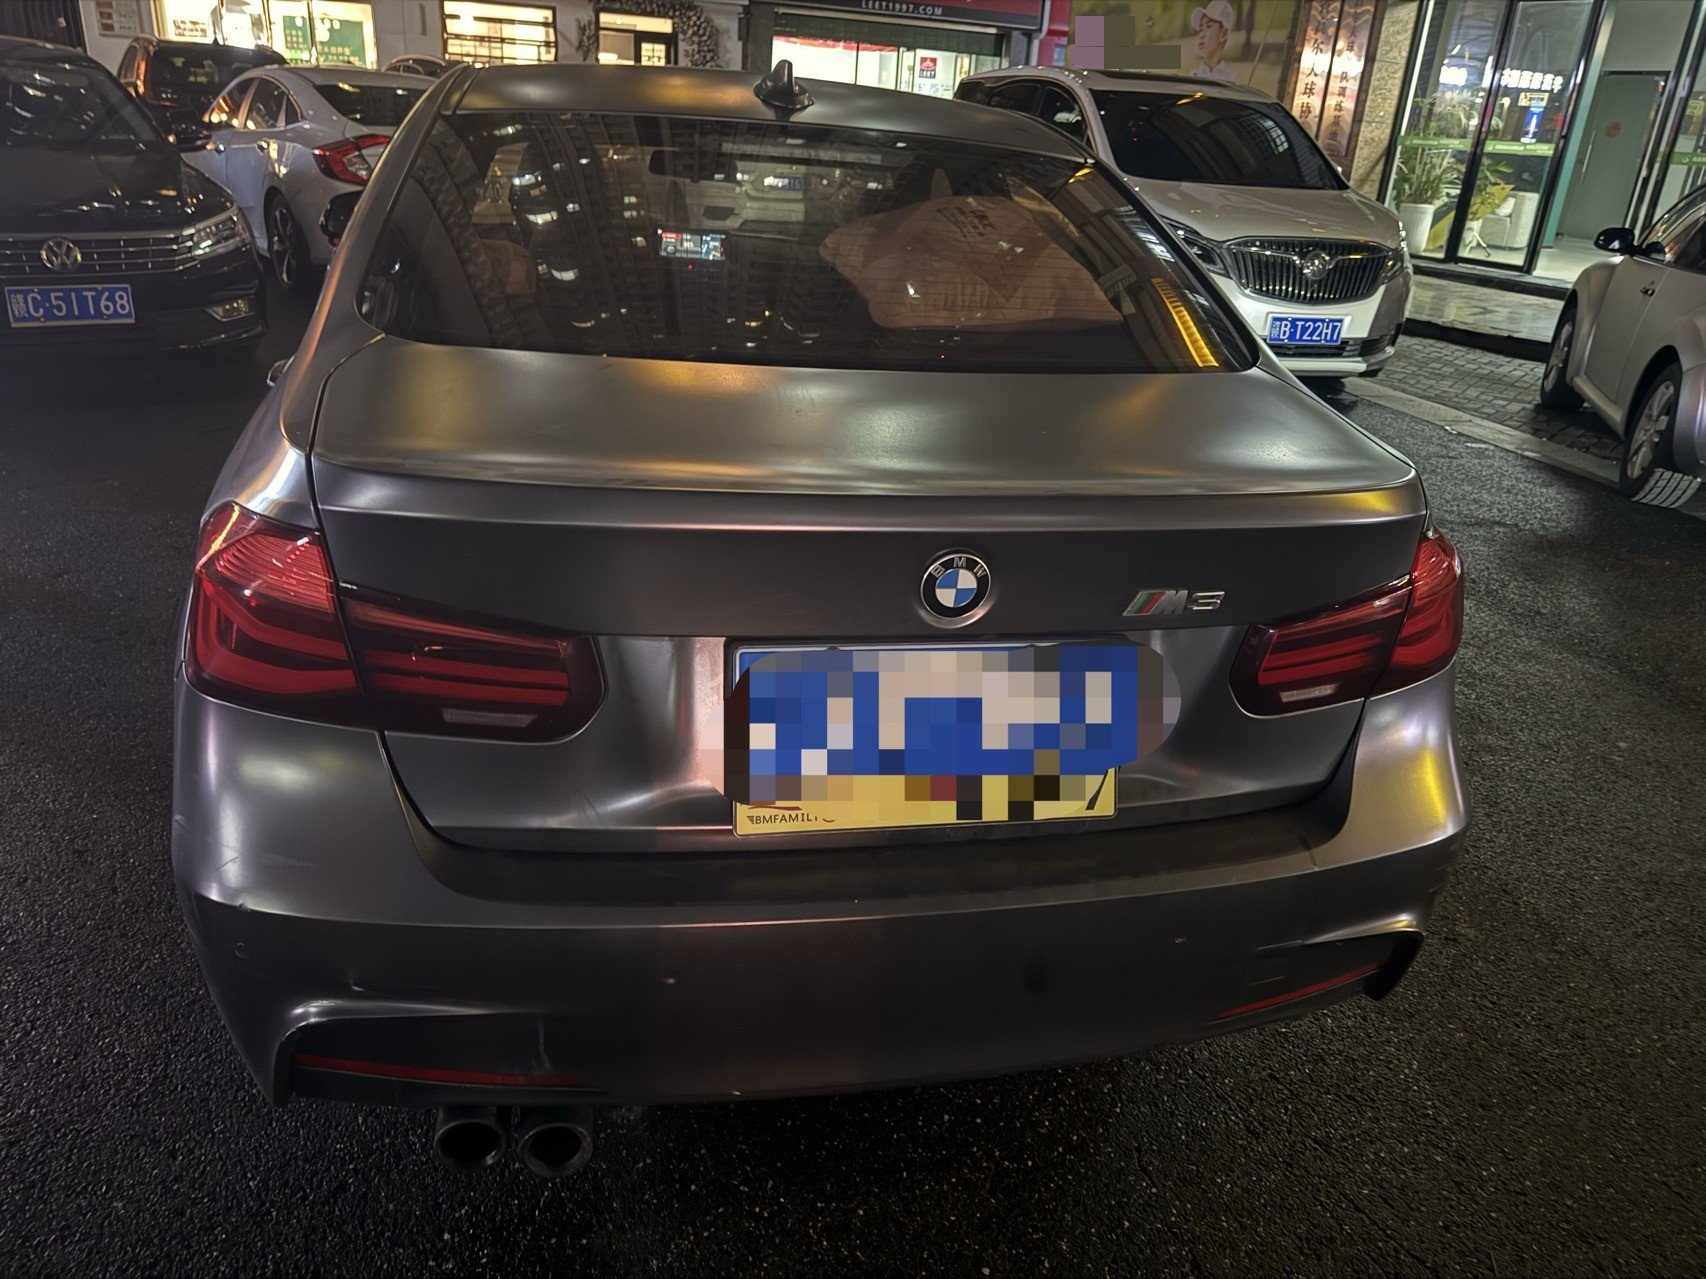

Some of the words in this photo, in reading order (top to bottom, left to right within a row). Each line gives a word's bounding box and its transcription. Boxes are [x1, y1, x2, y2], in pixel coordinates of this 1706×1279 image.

[862, 0, 943, 15] LEET1997.COM
[930, 556, 987, 577] BMW
[1148, 589, 1225, 614] M3
